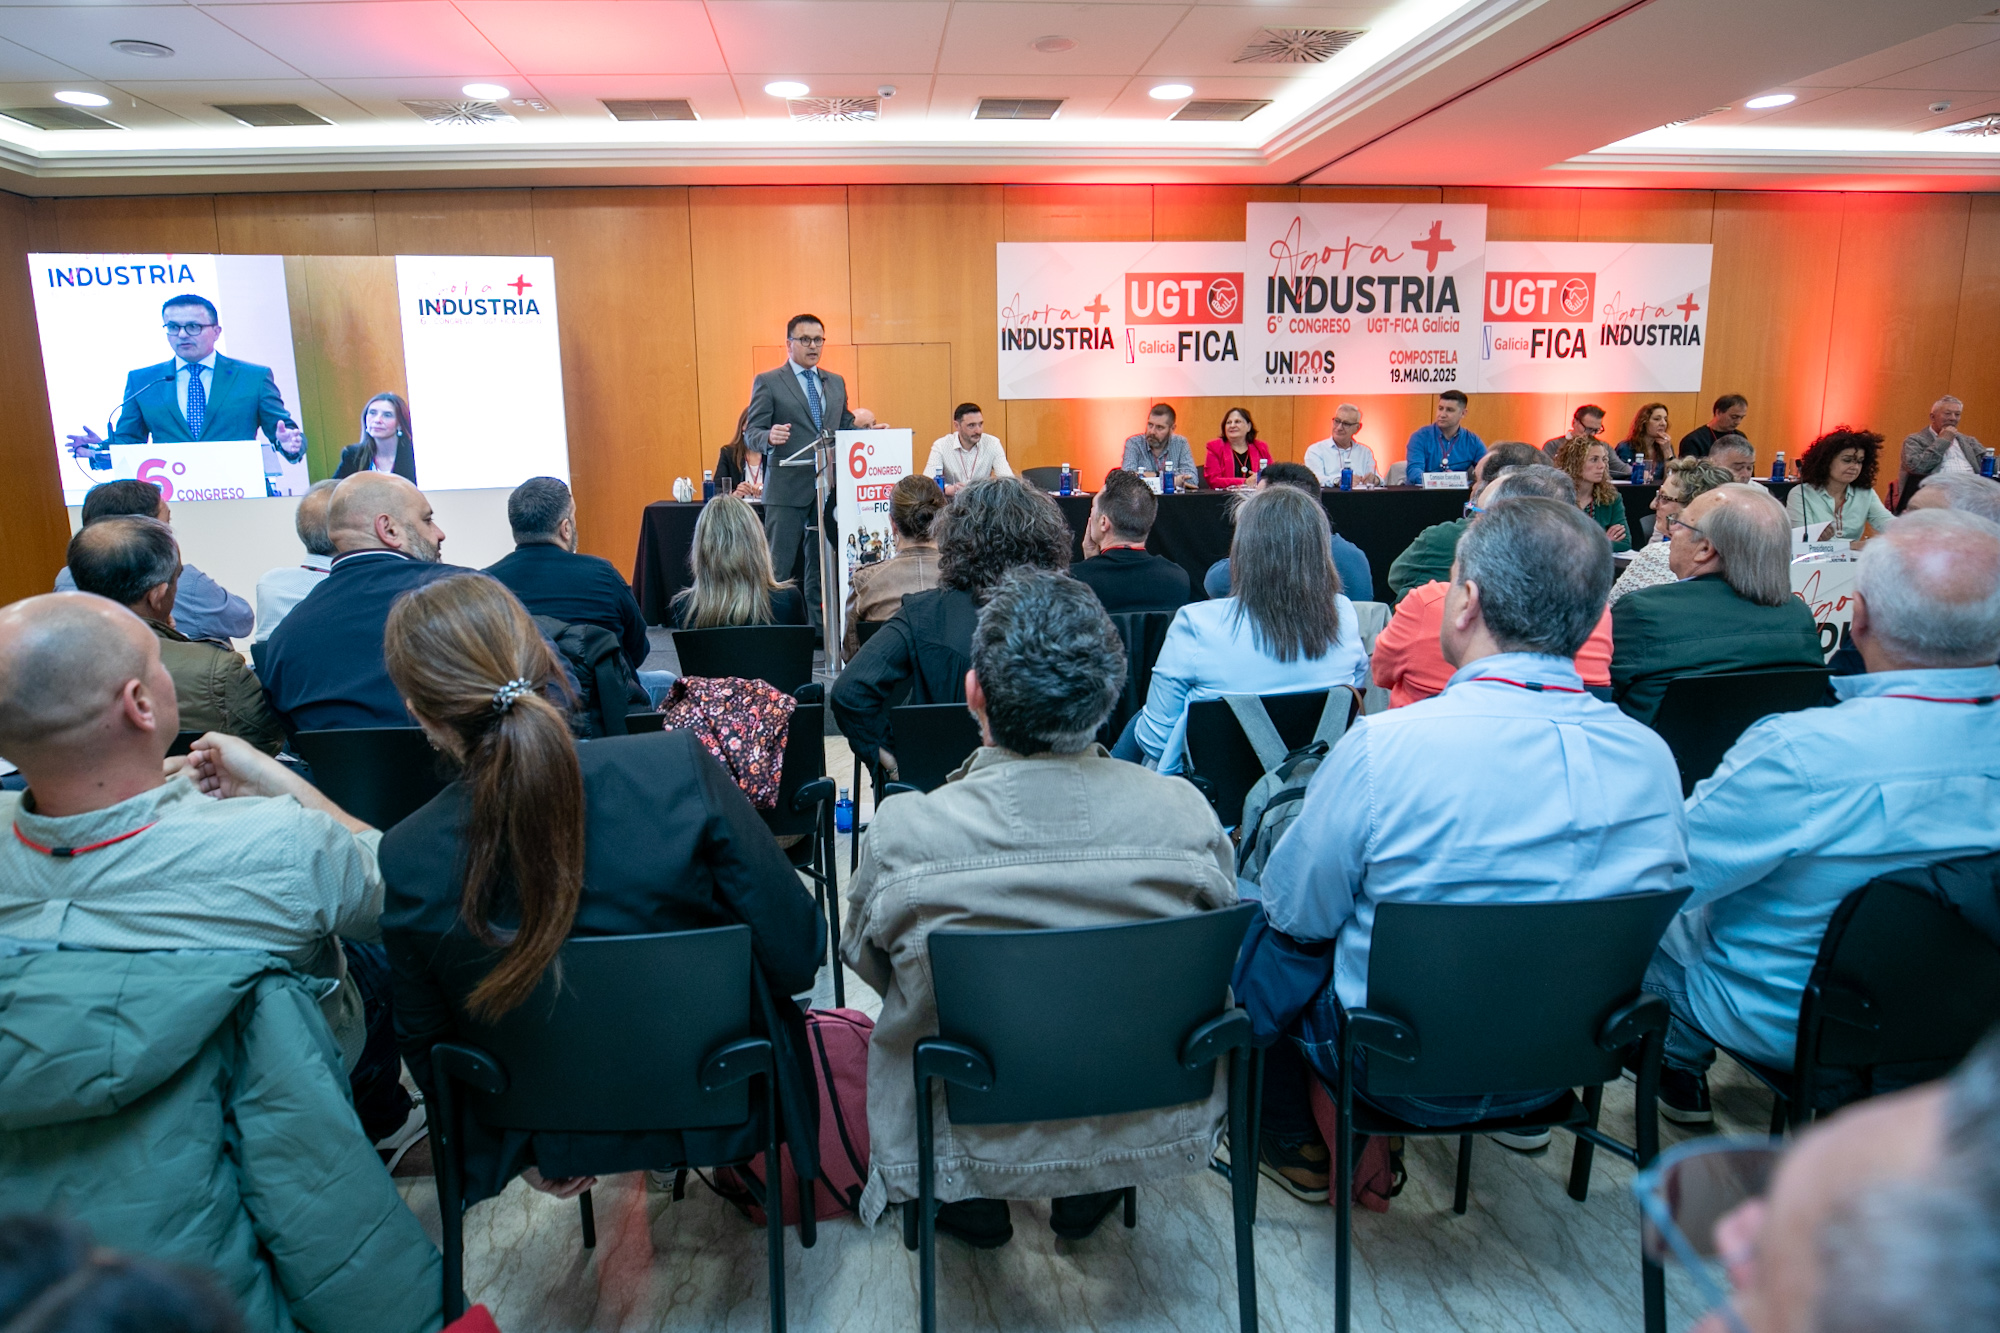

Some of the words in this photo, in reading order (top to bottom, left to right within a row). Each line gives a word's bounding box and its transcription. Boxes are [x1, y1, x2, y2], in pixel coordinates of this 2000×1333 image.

[48, 264, 195, 288] INDUSTRIA
[1131, 280, 1203, 318] UGT
[1267, 276, 1460, 314] INDUSTRIA
[1489, 279, 1557, 316] UGT
[418, 298, 540, 316] INDUSTRIA
[1289, 318, 1351, 334] CONGRESO
[1367, 317, 1419, 333] UGT-FICA
[1422, 316, 1460, 333] Galicia
[1001, 327, 1115, 351] INDUSTRIA
[1494, 337, 1529, 351] Galicia
[1530, 328, 1588, 359] FICA
[1600, 324, 1701, 346] INDUSTRIA
[1138, 340, 1176, 354] Galicia
[1178, 330, 1239, 362] FICA
[1389, 350, 1458, 365] COMPOSTELA
[1265, 375, 1335, 384] AVANZAMOS
[1390, 368, 1457, 383] 19.MAIO.2025
[868, 465, 902, 477] CONGRESO
[177, 487, 245, 501] CONGRESO
[858, 485, 882, 500] UGT
[874, 502, 891, 513] FIC
[1809, 544, 1834, 552] Presidencia
[1792, 570, 1855, 633] Ago
